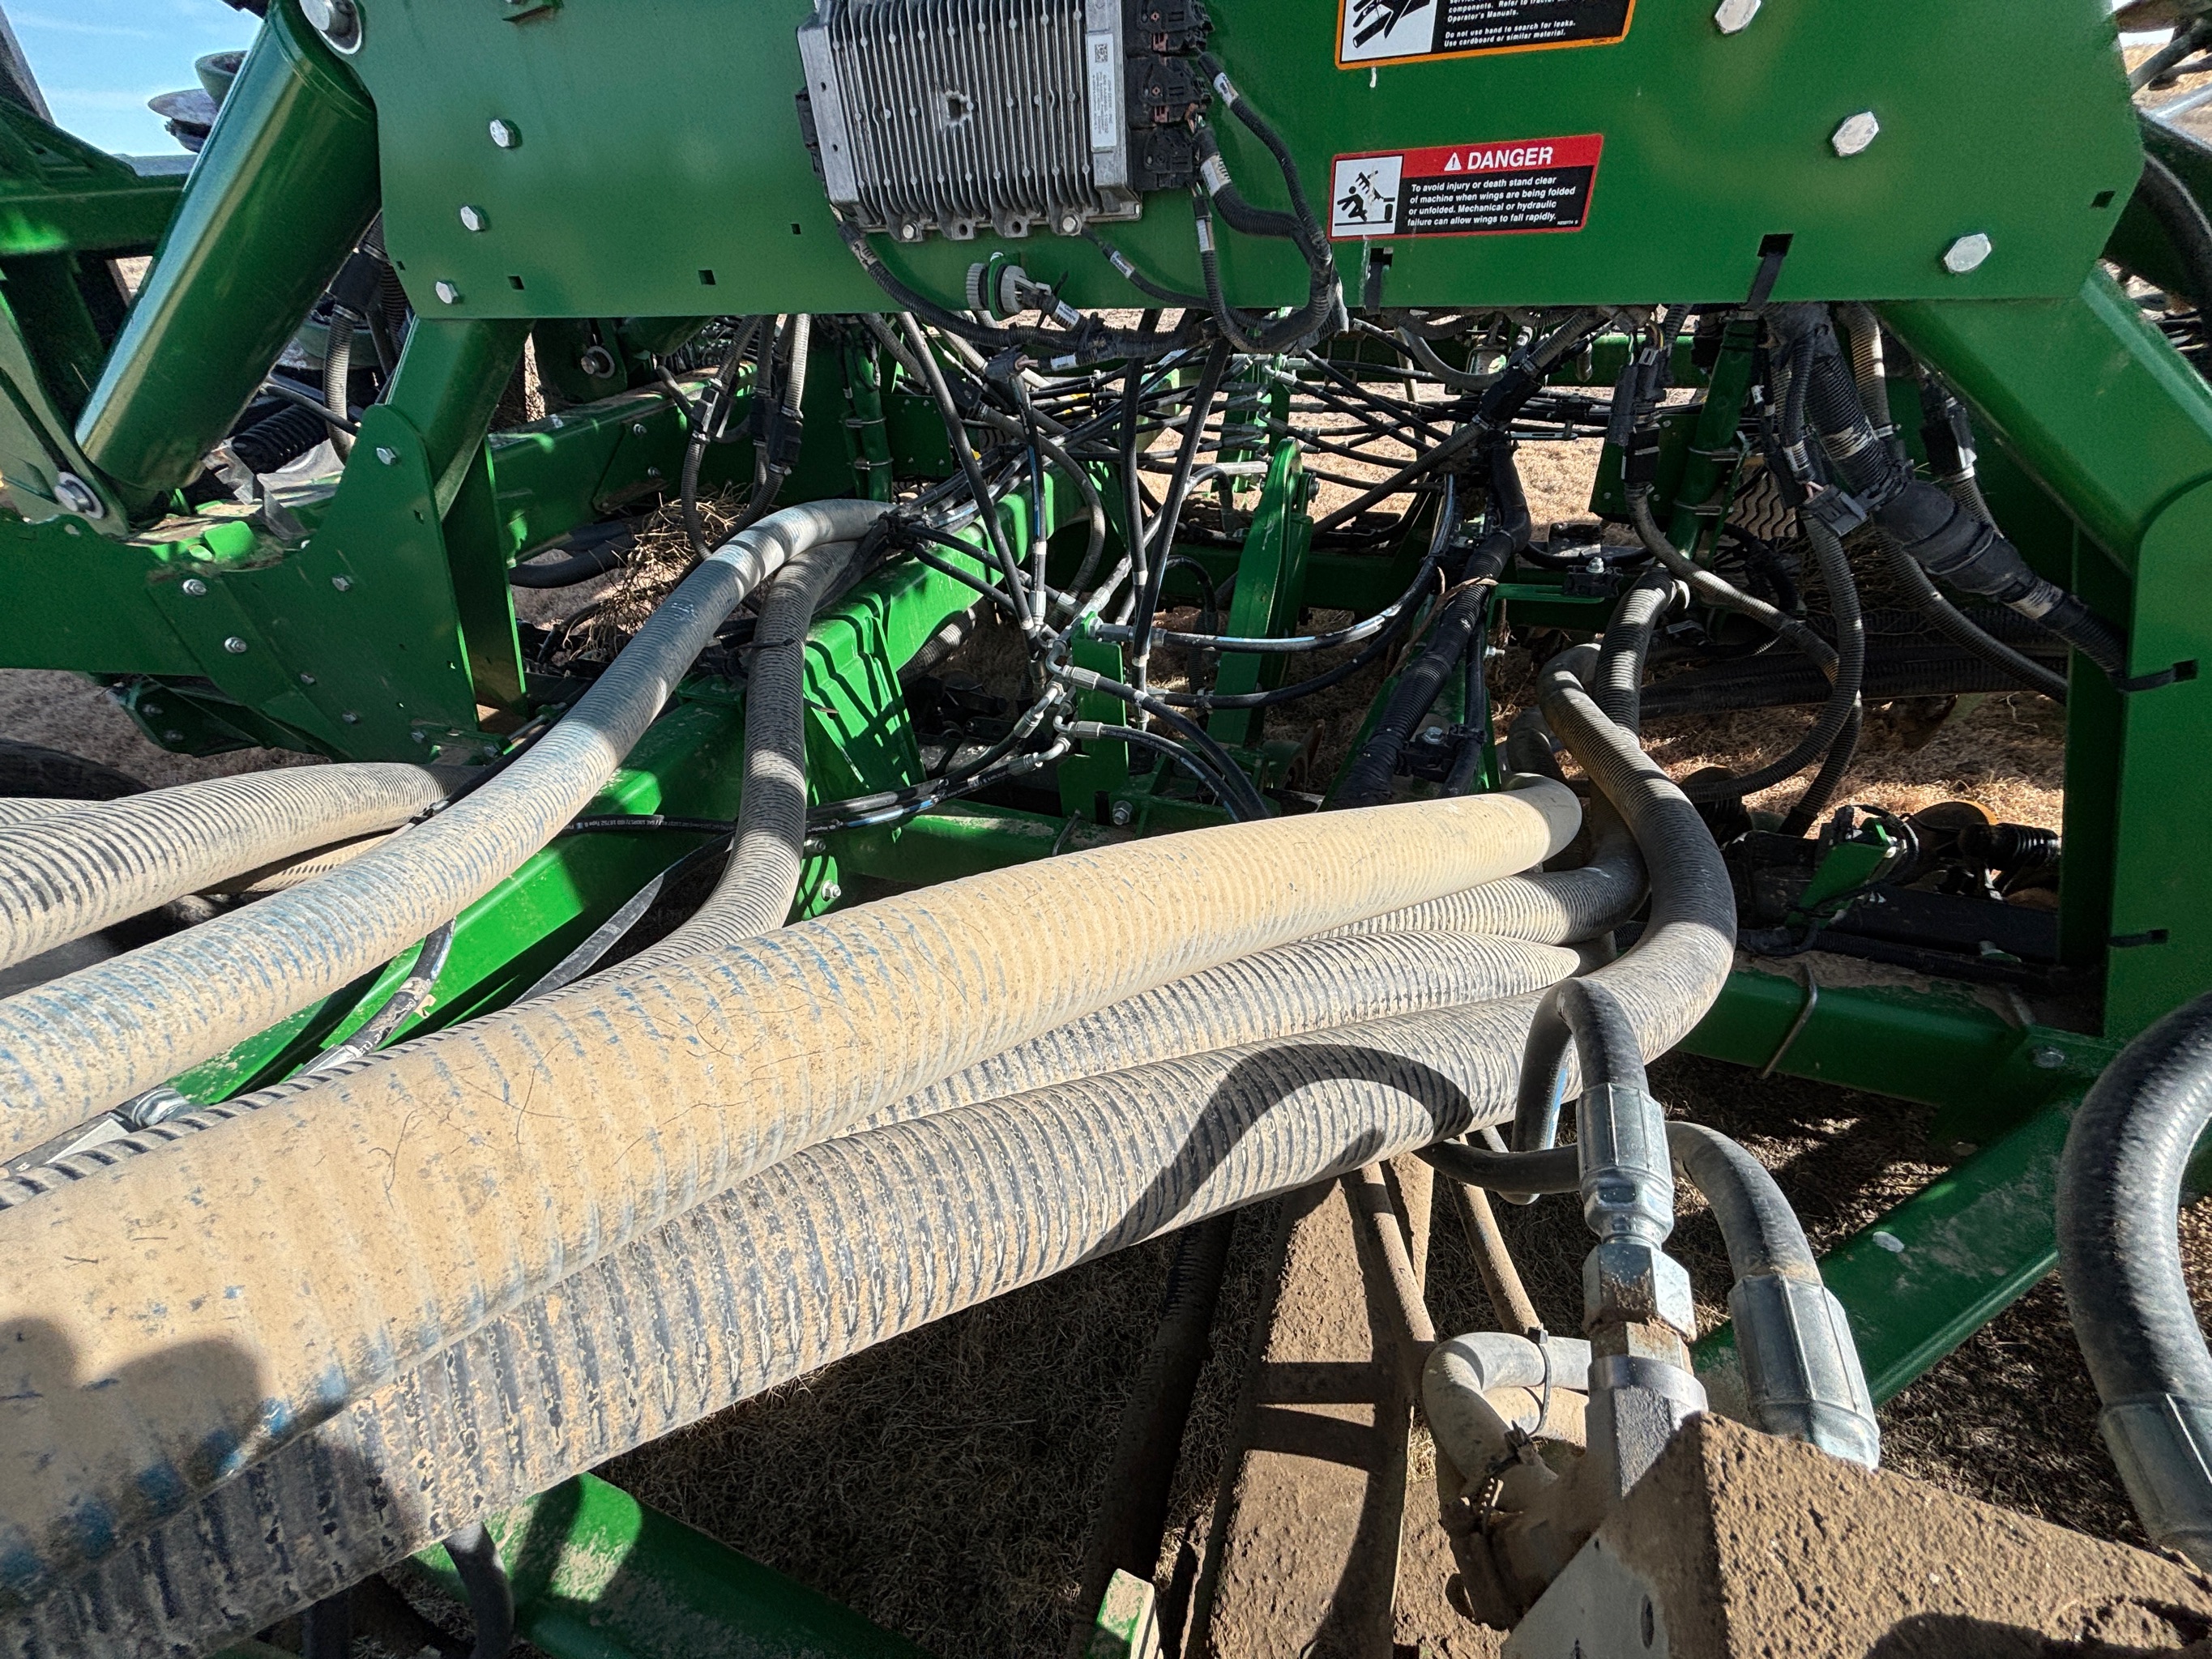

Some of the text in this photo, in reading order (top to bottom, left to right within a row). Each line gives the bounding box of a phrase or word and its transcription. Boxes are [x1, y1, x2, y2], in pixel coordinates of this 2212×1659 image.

[1449, 2, 1493, 13] components.
[1447, 8, 1519, 23] Operator's Manuals.
[1484, 26, 1503, 34] hand
[1514, 23, 1539, 32] search
[1540, 21, 1552, 29] for
[1553, 19, 1576, 28] leaks.
[1444, 40, 1457, 48] Use
[1458, 35, 1495, 45] cardboard
[1506, 32, 1532, 41] similar
[1533, 28, 1566, 38] material.
[1467, 146, 1553, 170] DANGER
[1411, 184, 1421, 193] To
[1423, 182, 1445, 192] avoid
[1446, 181, 1470, 191] injury
[1484, 179, 1506, 188] death
[1509, 177, 1533, 187] stand
[1535, 177, 1557, 186] clear
[1410, 186, 1576, 204] of machine when wings are being folded
[1419, 205, 1456, 215] unfolded.
[1458, 203, 1504, 213] Mechanical
[1517, 200, 1557, 211] hydraulic
[1407, 218, 1432, 226] failure
[1450, 216, 1471, 224] allow
[1473, 215, 1497, 225] wings
[1510, 213, 1524, 222] fall
[1526, 212, 1557, 223] rapidly.
